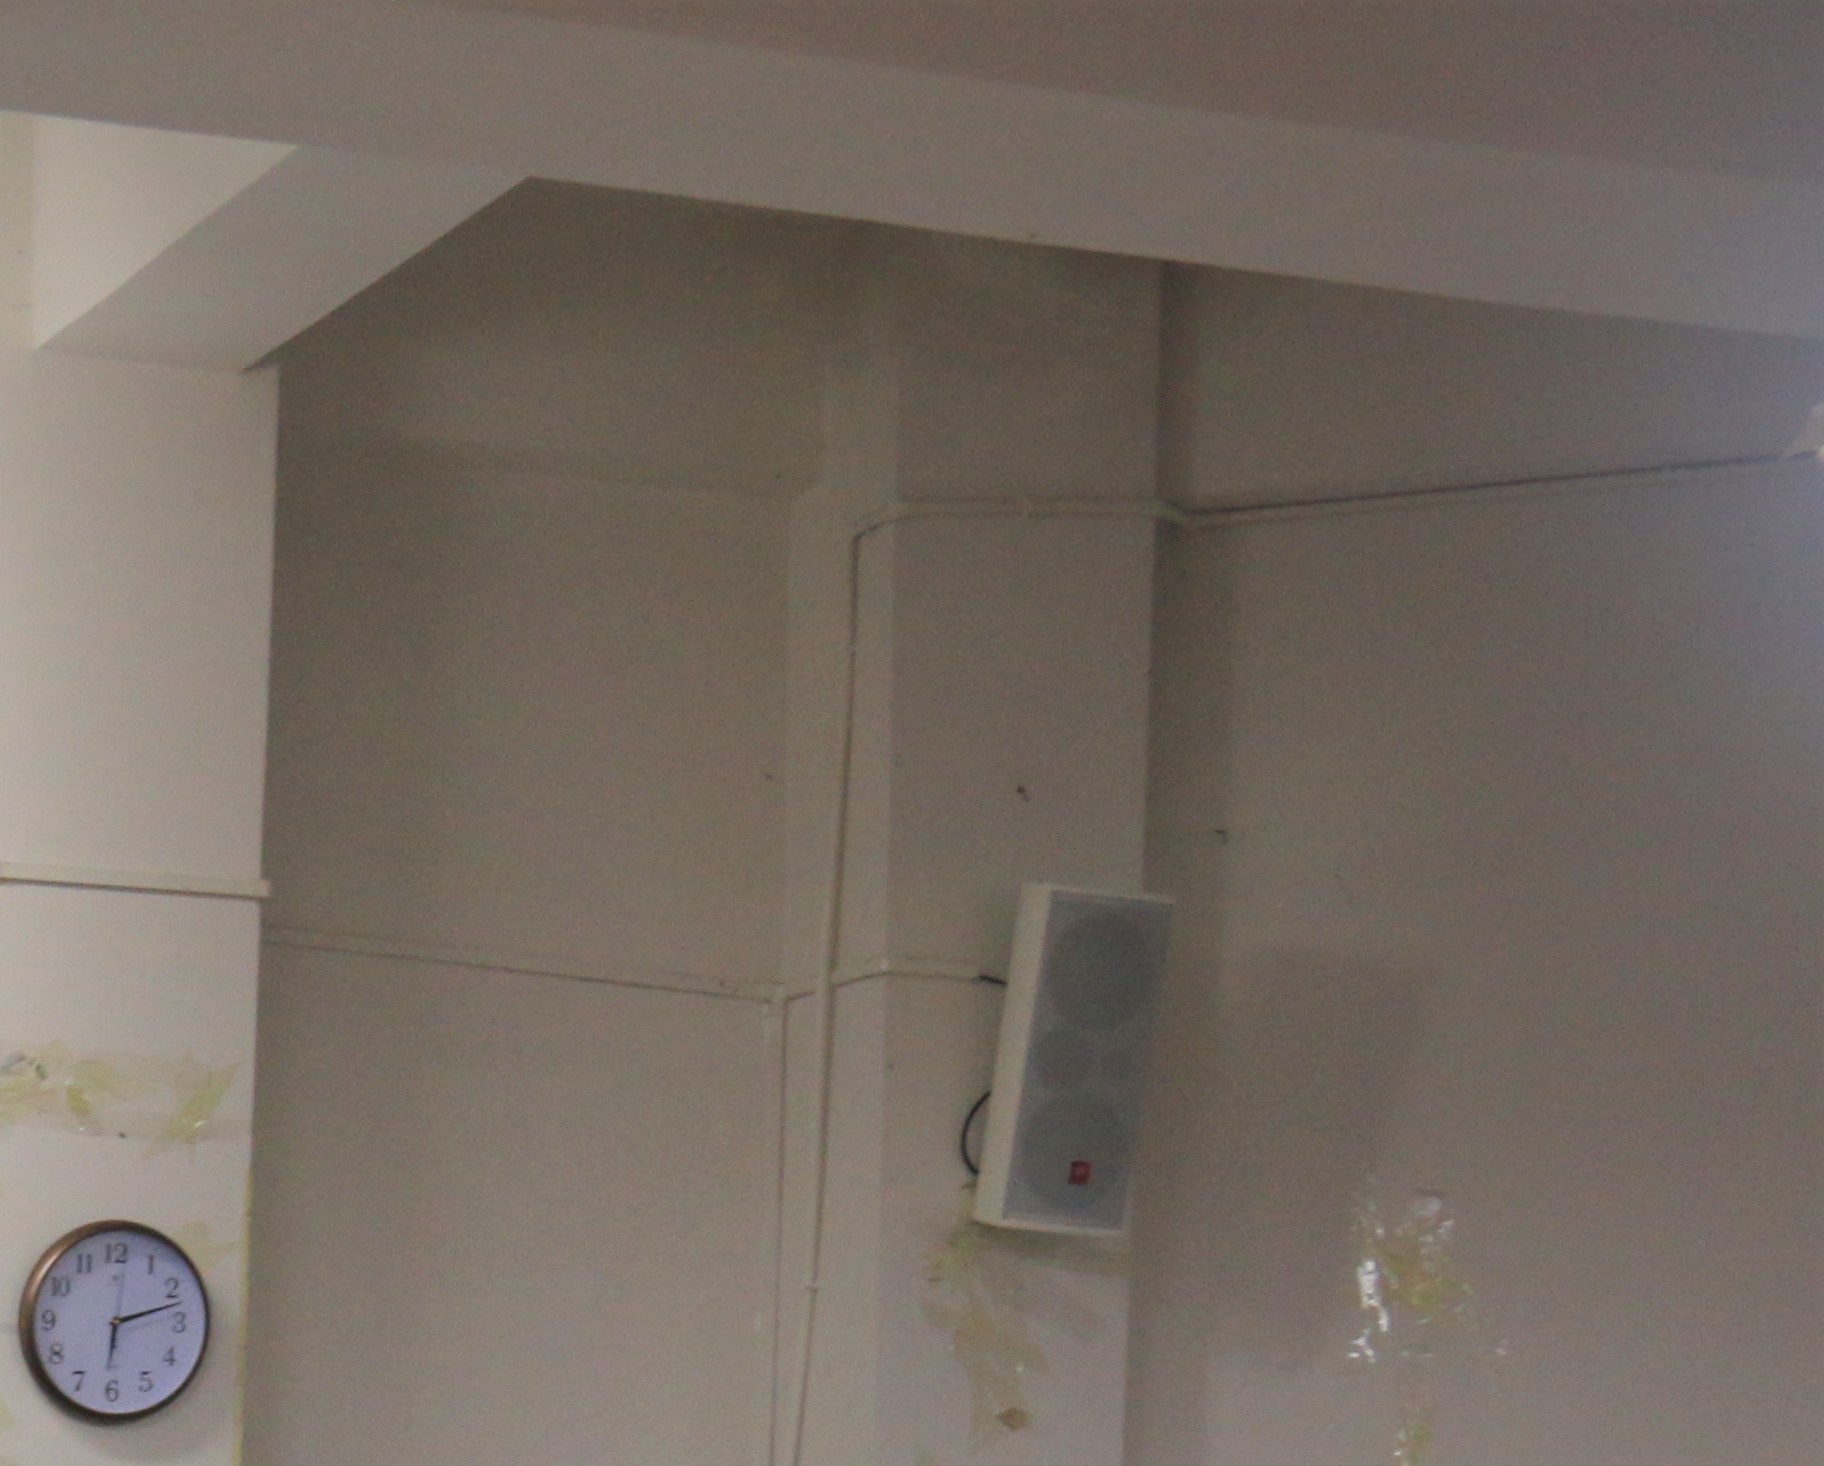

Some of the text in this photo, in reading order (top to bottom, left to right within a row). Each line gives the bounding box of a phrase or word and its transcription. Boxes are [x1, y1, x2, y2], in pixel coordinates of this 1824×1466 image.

[104, 1242, 128, 1263] 12
[76, 1253, 93, 1274] 11
[147, 1254, 155, 1275] 1
[51, 1276, 71, 1297] 10
[164, 1277, 180, 1299] 2
[41, 1310, 56, 1331] 9
[172, 1311, 186, 1334] 3
[49, 1344, 64, 1365] 8
[163, 1346, 176, 1367] 4
[71, 1370, 86, 1392] 7
[105, 1380, 120, 1402] 6
[138, 1370, 154, 1393] 5
